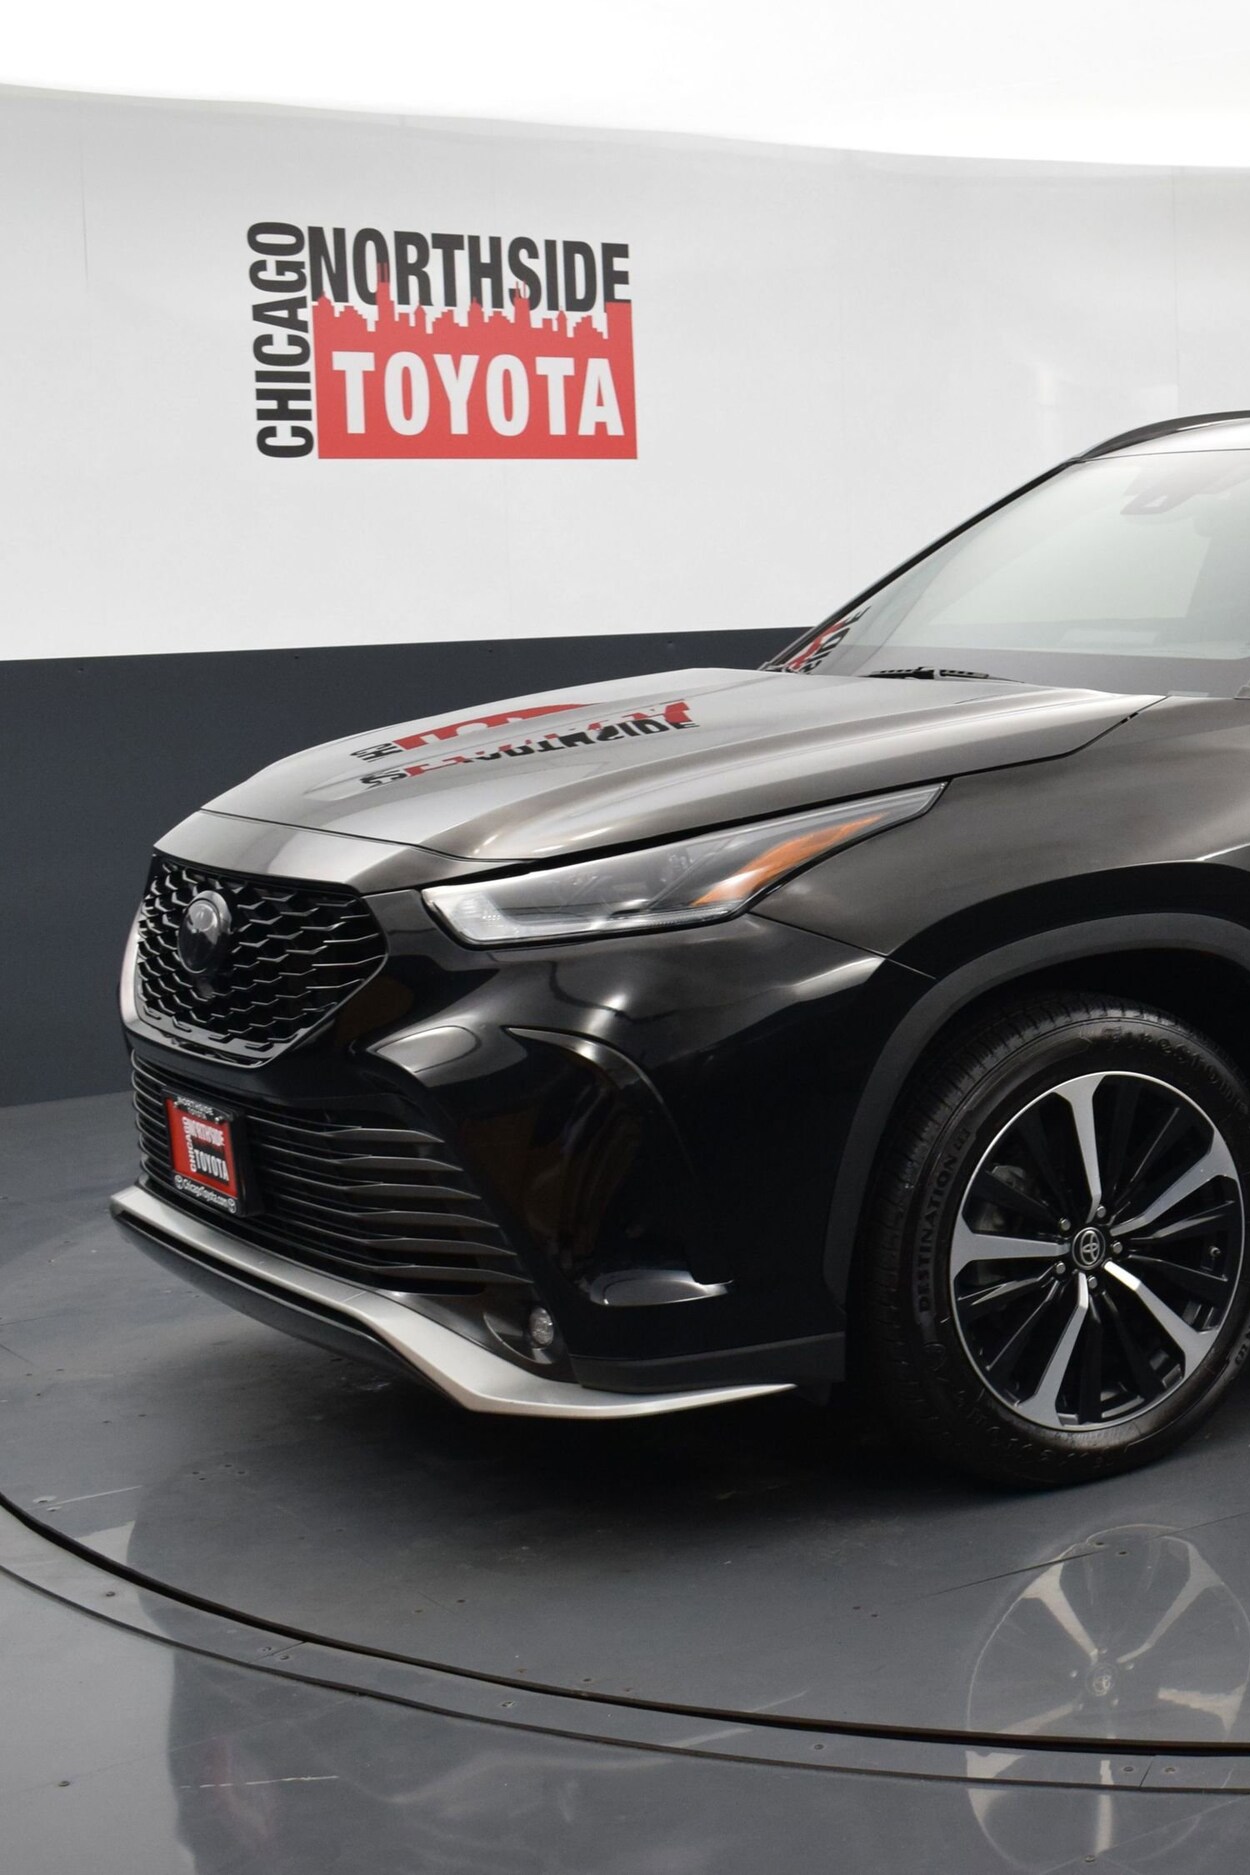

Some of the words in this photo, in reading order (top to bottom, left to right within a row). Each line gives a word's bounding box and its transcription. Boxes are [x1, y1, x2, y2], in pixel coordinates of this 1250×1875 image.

[308, 226, 630, 313] NORTHSIDE
[247, 221, 314, 459] CHICAGO
[332, 351, 625, 437] TOYOTA
[194, 1148, 230, 1182] TOYOTA
[917, 1154, 959, 1314] DESTINATION
